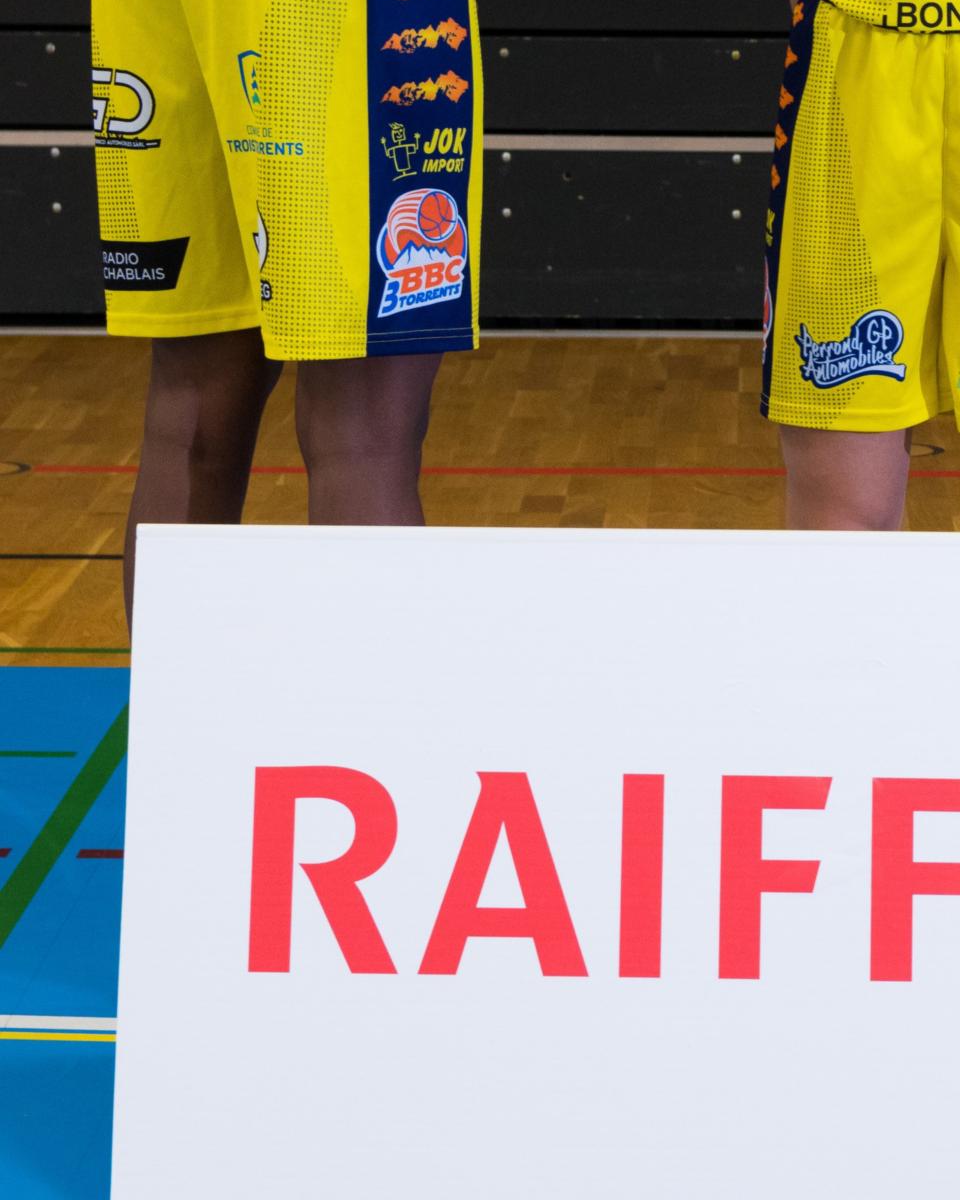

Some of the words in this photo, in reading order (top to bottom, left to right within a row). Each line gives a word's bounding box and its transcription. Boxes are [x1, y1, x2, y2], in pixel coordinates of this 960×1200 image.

[423, 128, 467, 154] JOK
[422, 157, 465, 173] IMPORT
[102, 251, 139, 265] RADIO
[103, 267, 166, 280] CHABLAIS
[388, 258, 464, 294] BBC
[380, 280, 401, 315] 3
[400, 283, 461, 307] TORRENTS
[866, 318, 892, 350] GP
